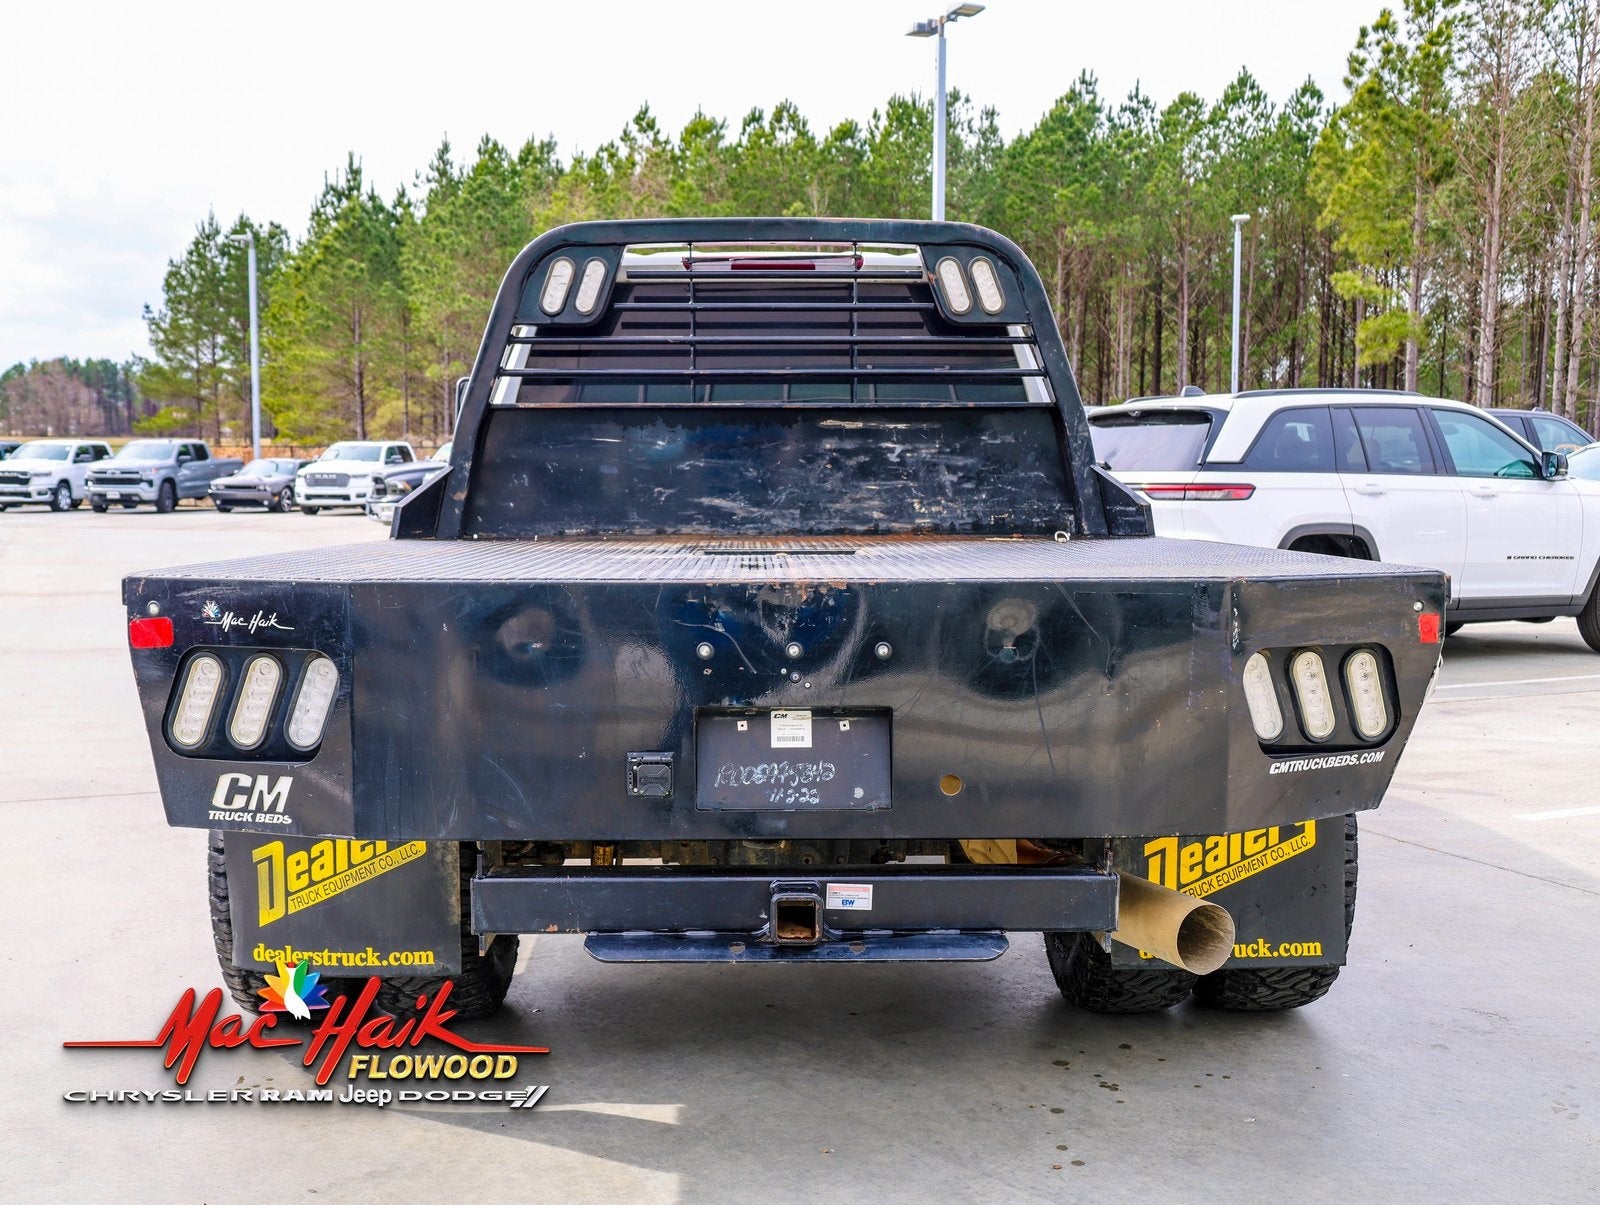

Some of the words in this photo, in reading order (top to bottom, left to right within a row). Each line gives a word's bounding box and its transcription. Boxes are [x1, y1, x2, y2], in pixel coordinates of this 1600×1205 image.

[204, 611, 248, 632] Mac
[248, 610, 295, 634] Haik
[1269, 751, 1385, 774] CMTRUCKBEDS.COM
[212, 772, 294, 813] CM
[208, 810, 254, 822] TRUCK
[255, 813, 293, 825] BEDS
[1216, 853, 1269, 887] EQUIPMENT
[1290, 835, 1312, 852] LLC.
[291, 887, 323, 910] TRUCK
[323, 862, 378, 896] EQUIPMENT
[399, 844, 422, 861] LLC.
[253, 943, 435, 967] dealerstruck.com
